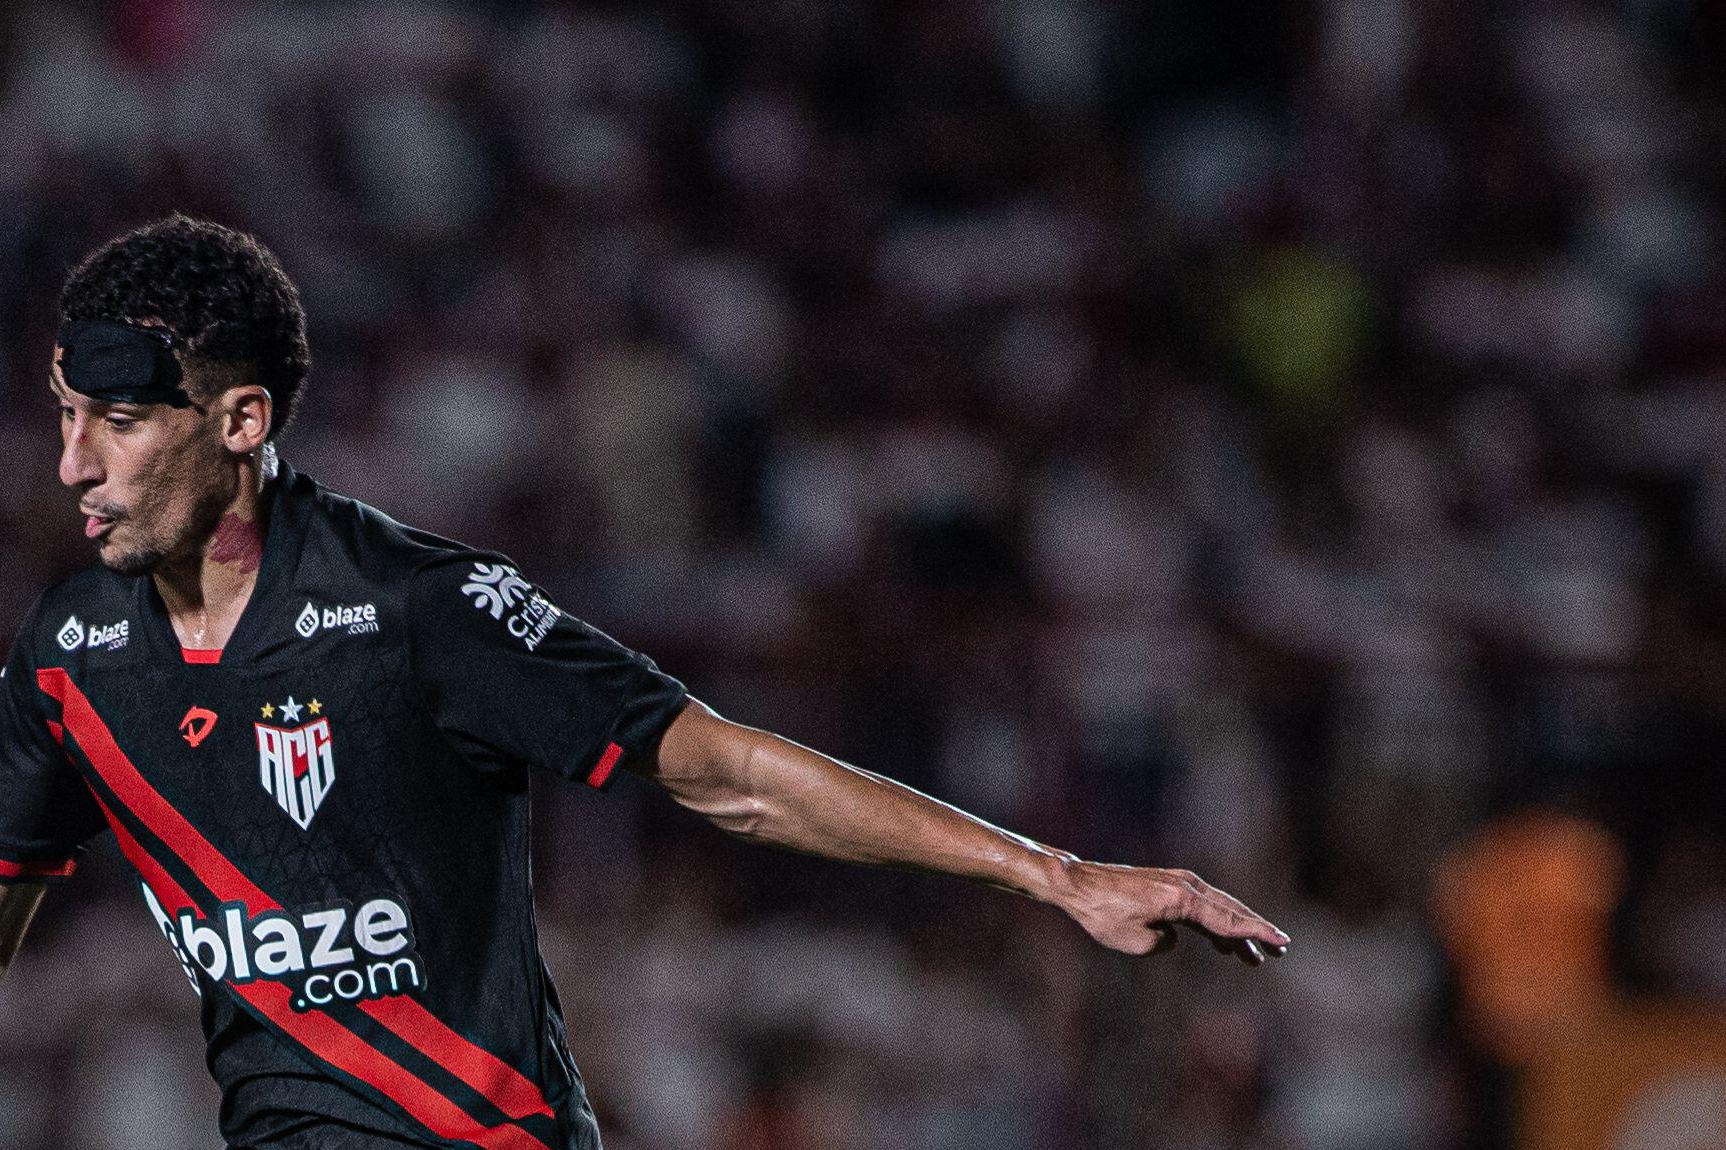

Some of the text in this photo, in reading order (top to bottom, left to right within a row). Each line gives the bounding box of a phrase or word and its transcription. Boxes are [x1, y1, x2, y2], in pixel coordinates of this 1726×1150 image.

[87, 619, 129, 648] blaze
[322, 603, 376, 629] blaze
[255, 717, 336, 831] ACG
[180, 899, 408, 981] blaze
[297, 957, 420, 1008] .com
